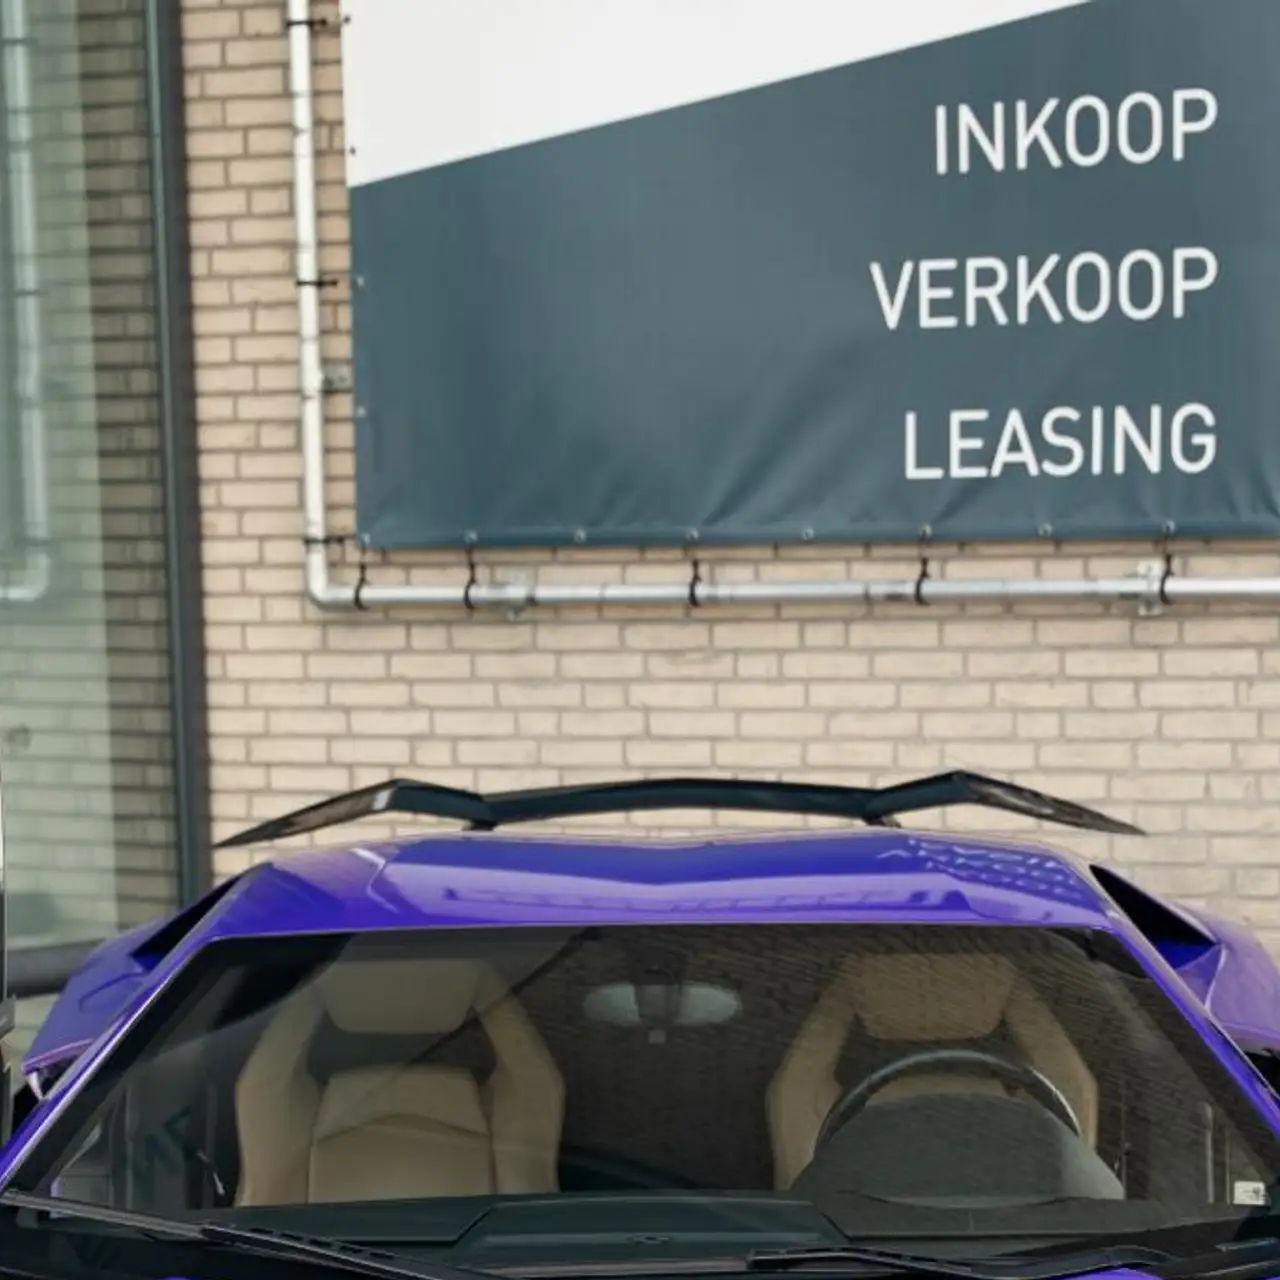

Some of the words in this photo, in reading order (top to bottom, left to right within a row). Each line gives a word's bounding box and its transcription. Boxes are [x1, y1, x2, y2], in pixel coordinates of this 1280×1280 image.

[935, 87, 1219, 176] INKOOP
[869, 246, 1219, 331] VERKOOP
[904, 402, 1218, 480] LEASING
